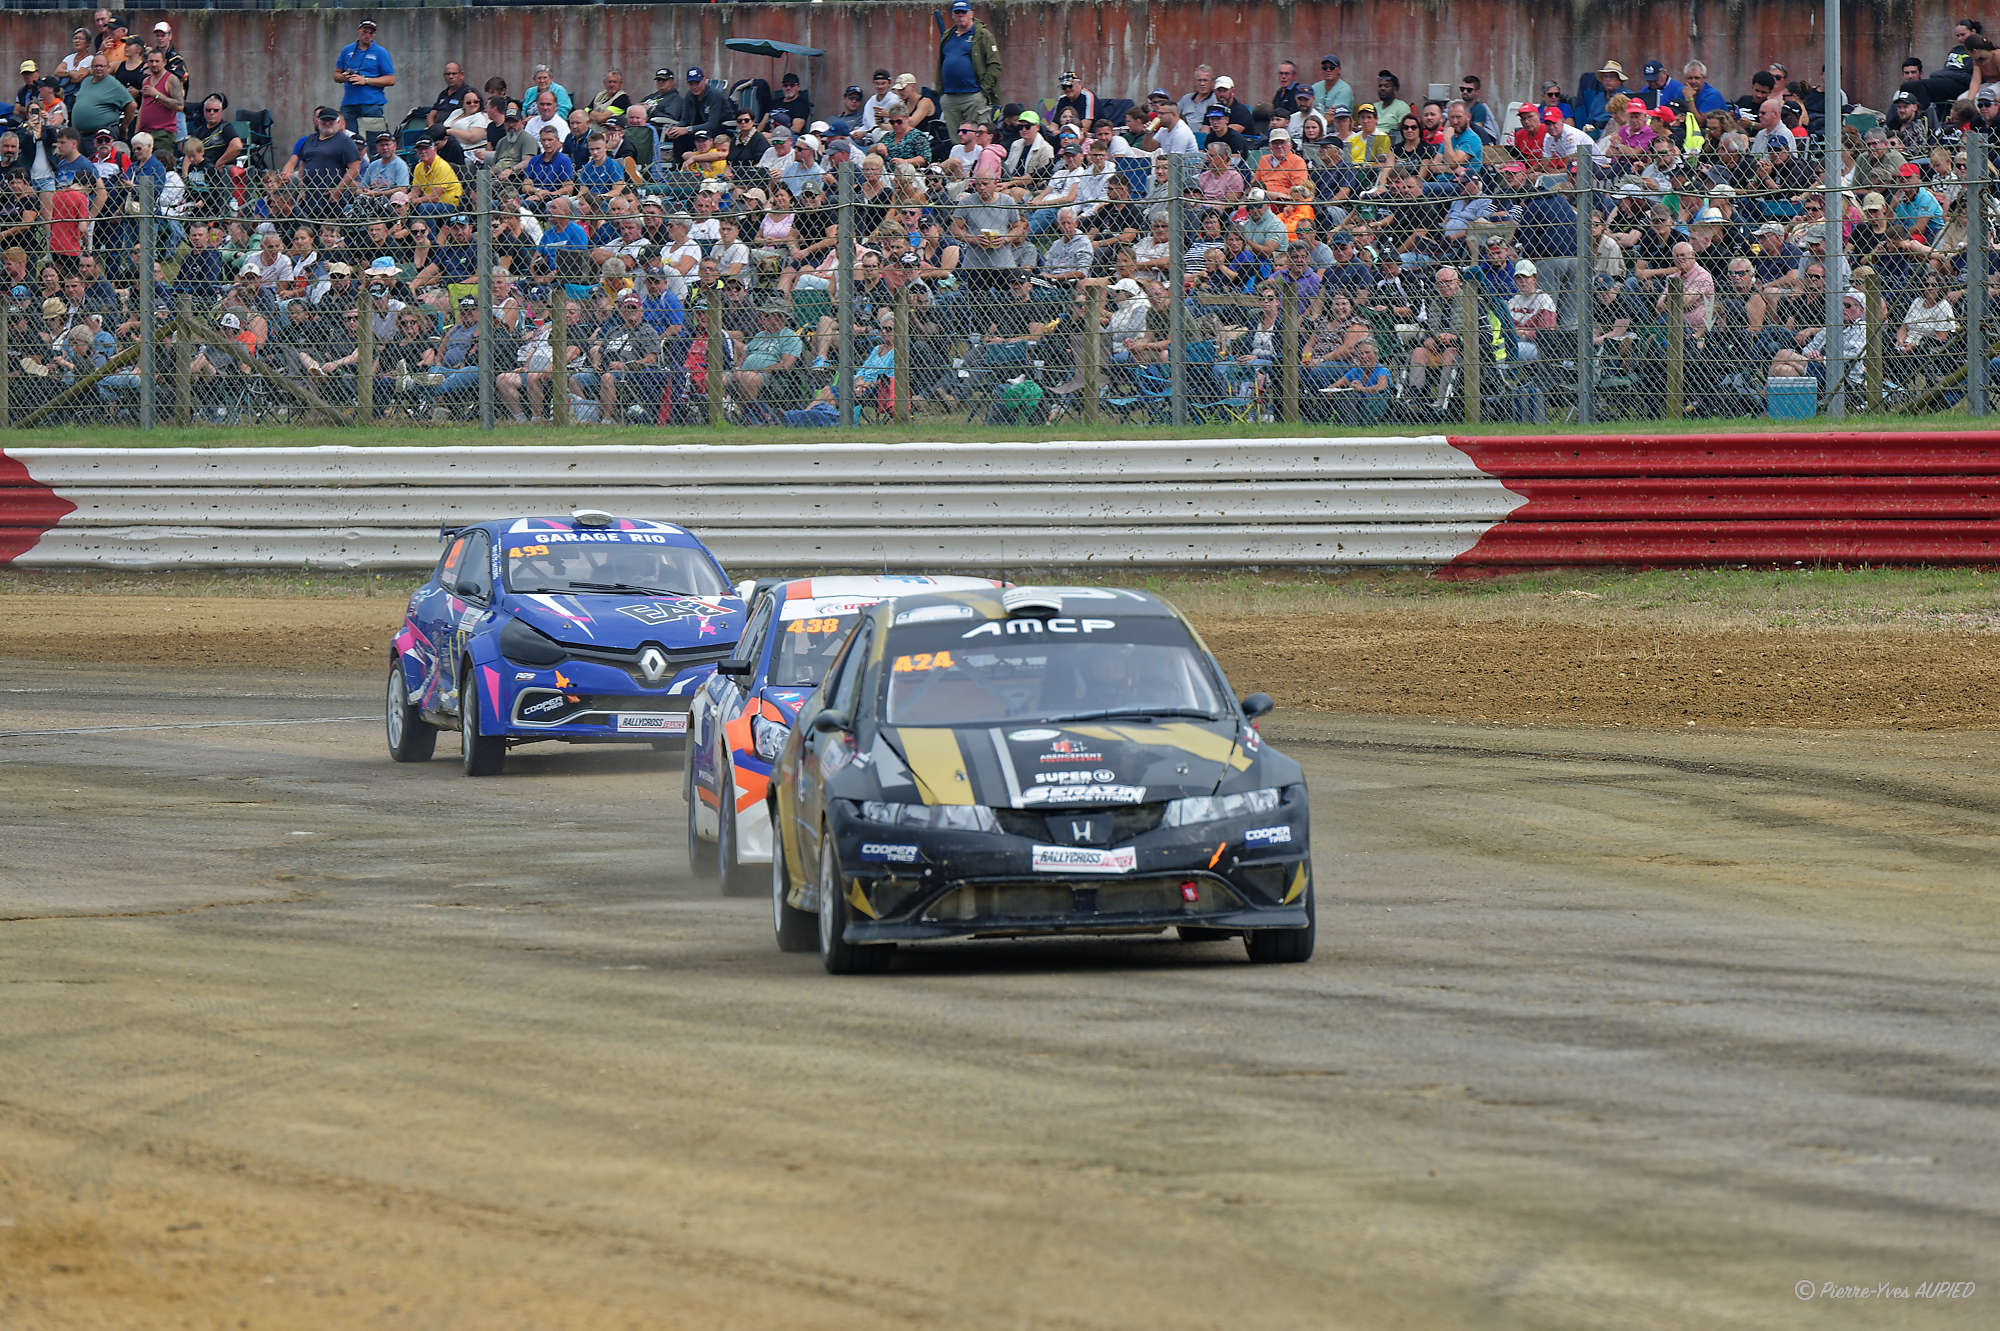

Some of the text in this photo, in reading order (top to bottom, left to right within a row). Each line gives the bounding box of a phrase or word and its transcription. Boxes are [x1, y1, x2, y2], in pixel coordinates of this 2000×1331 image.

[535, 532, 666, 544] GARAGE RIO
[508, 545, 550, 558] 499
[786, 618, 839, 633] 438
[961, 618, 1116, 639] AMCP
[893, 651, 955, 672] 424
[523, 695, 564, 715] COOPER
[622, 717, 664, 727] RALLYCROSS
[1035, 771, 1093, 784] SUPER
[1021, 784, 1147, 804] SERAZIN
[1245, 826, 1290, 840] COOPER
[862, 844, 918, 856] COOPER
[1040, 851, 1102, 864] RALLYCROSS
